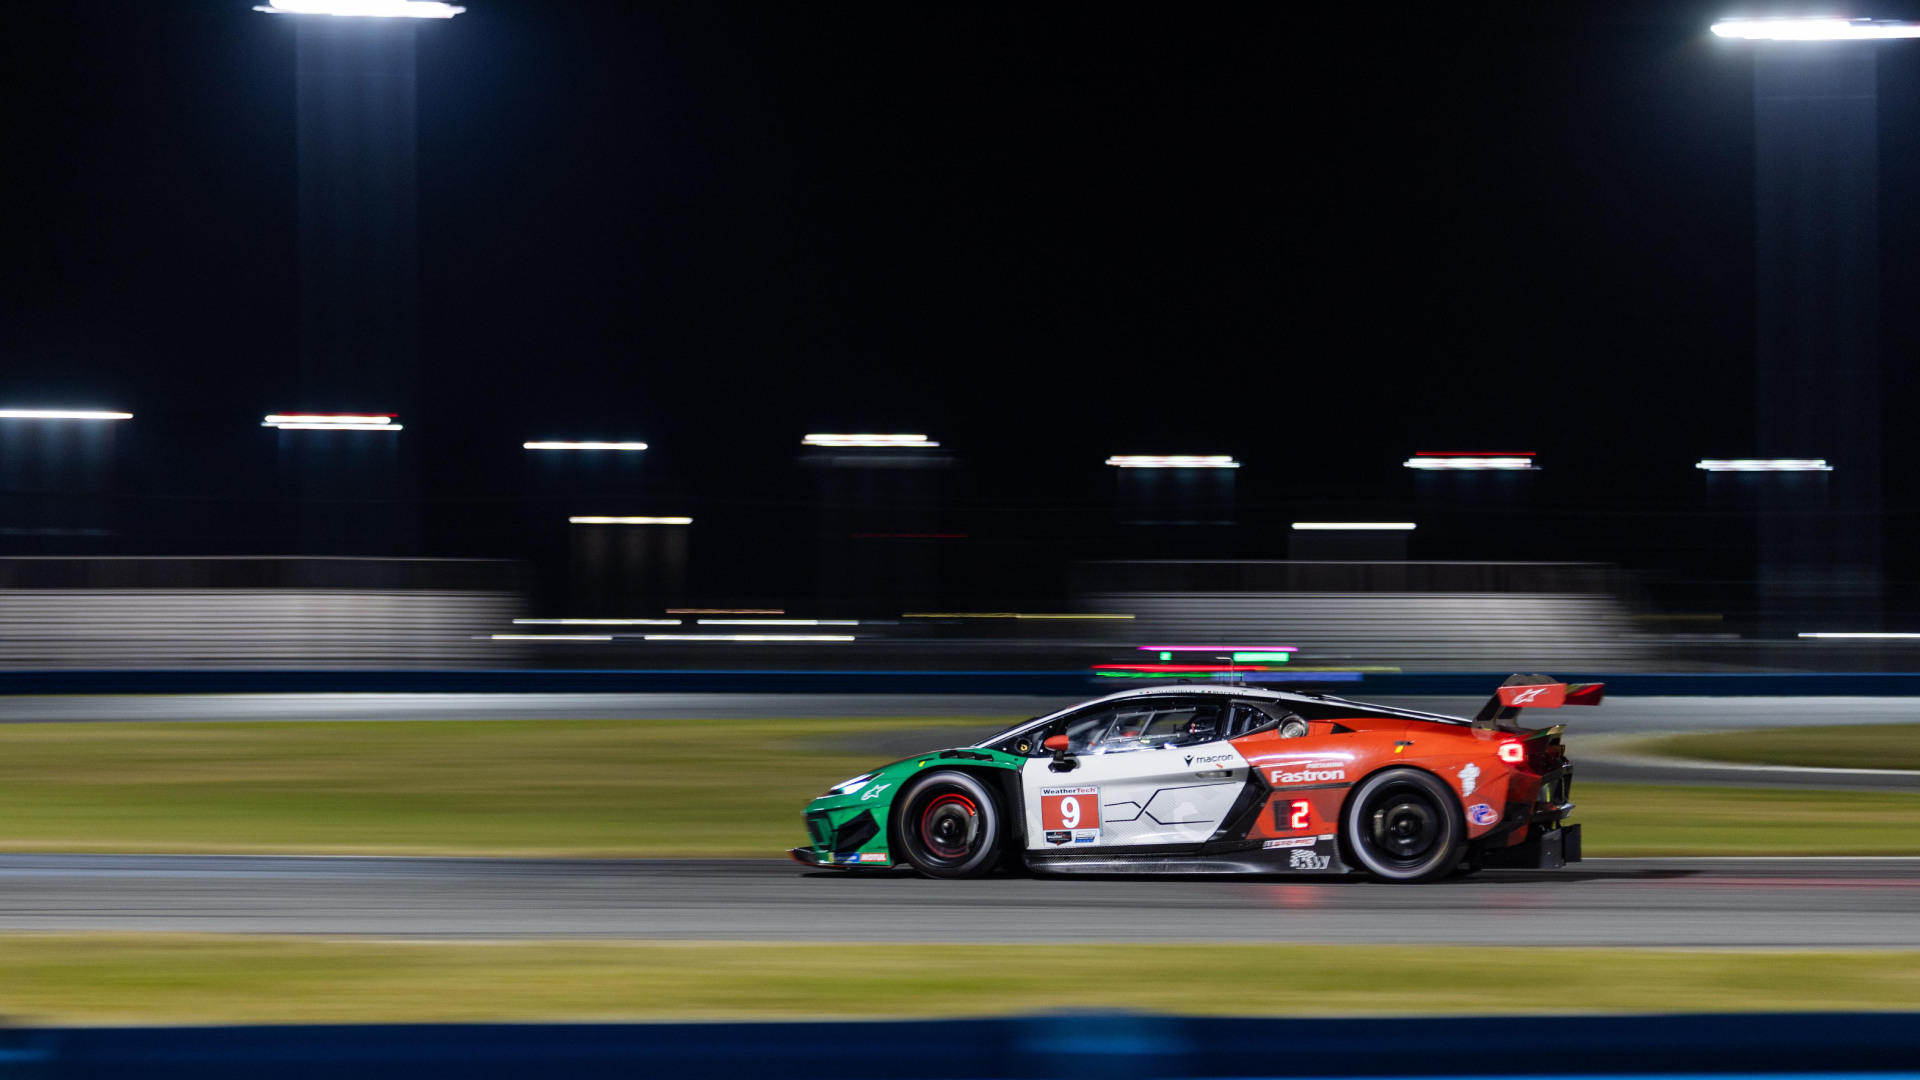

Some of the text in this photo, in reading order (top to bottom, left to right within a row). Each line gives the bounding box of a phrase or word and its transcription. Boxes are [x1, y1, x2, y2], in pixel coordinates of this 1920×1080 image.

[1196, 754, 1233, 764] macron
[1271, 769, 1345, 784] Fastron
[1043, 787, 1096, 795] WeatherTech
[1061, 796, 1080, 829] 9
[1292, 801, 1309, 829] 2
